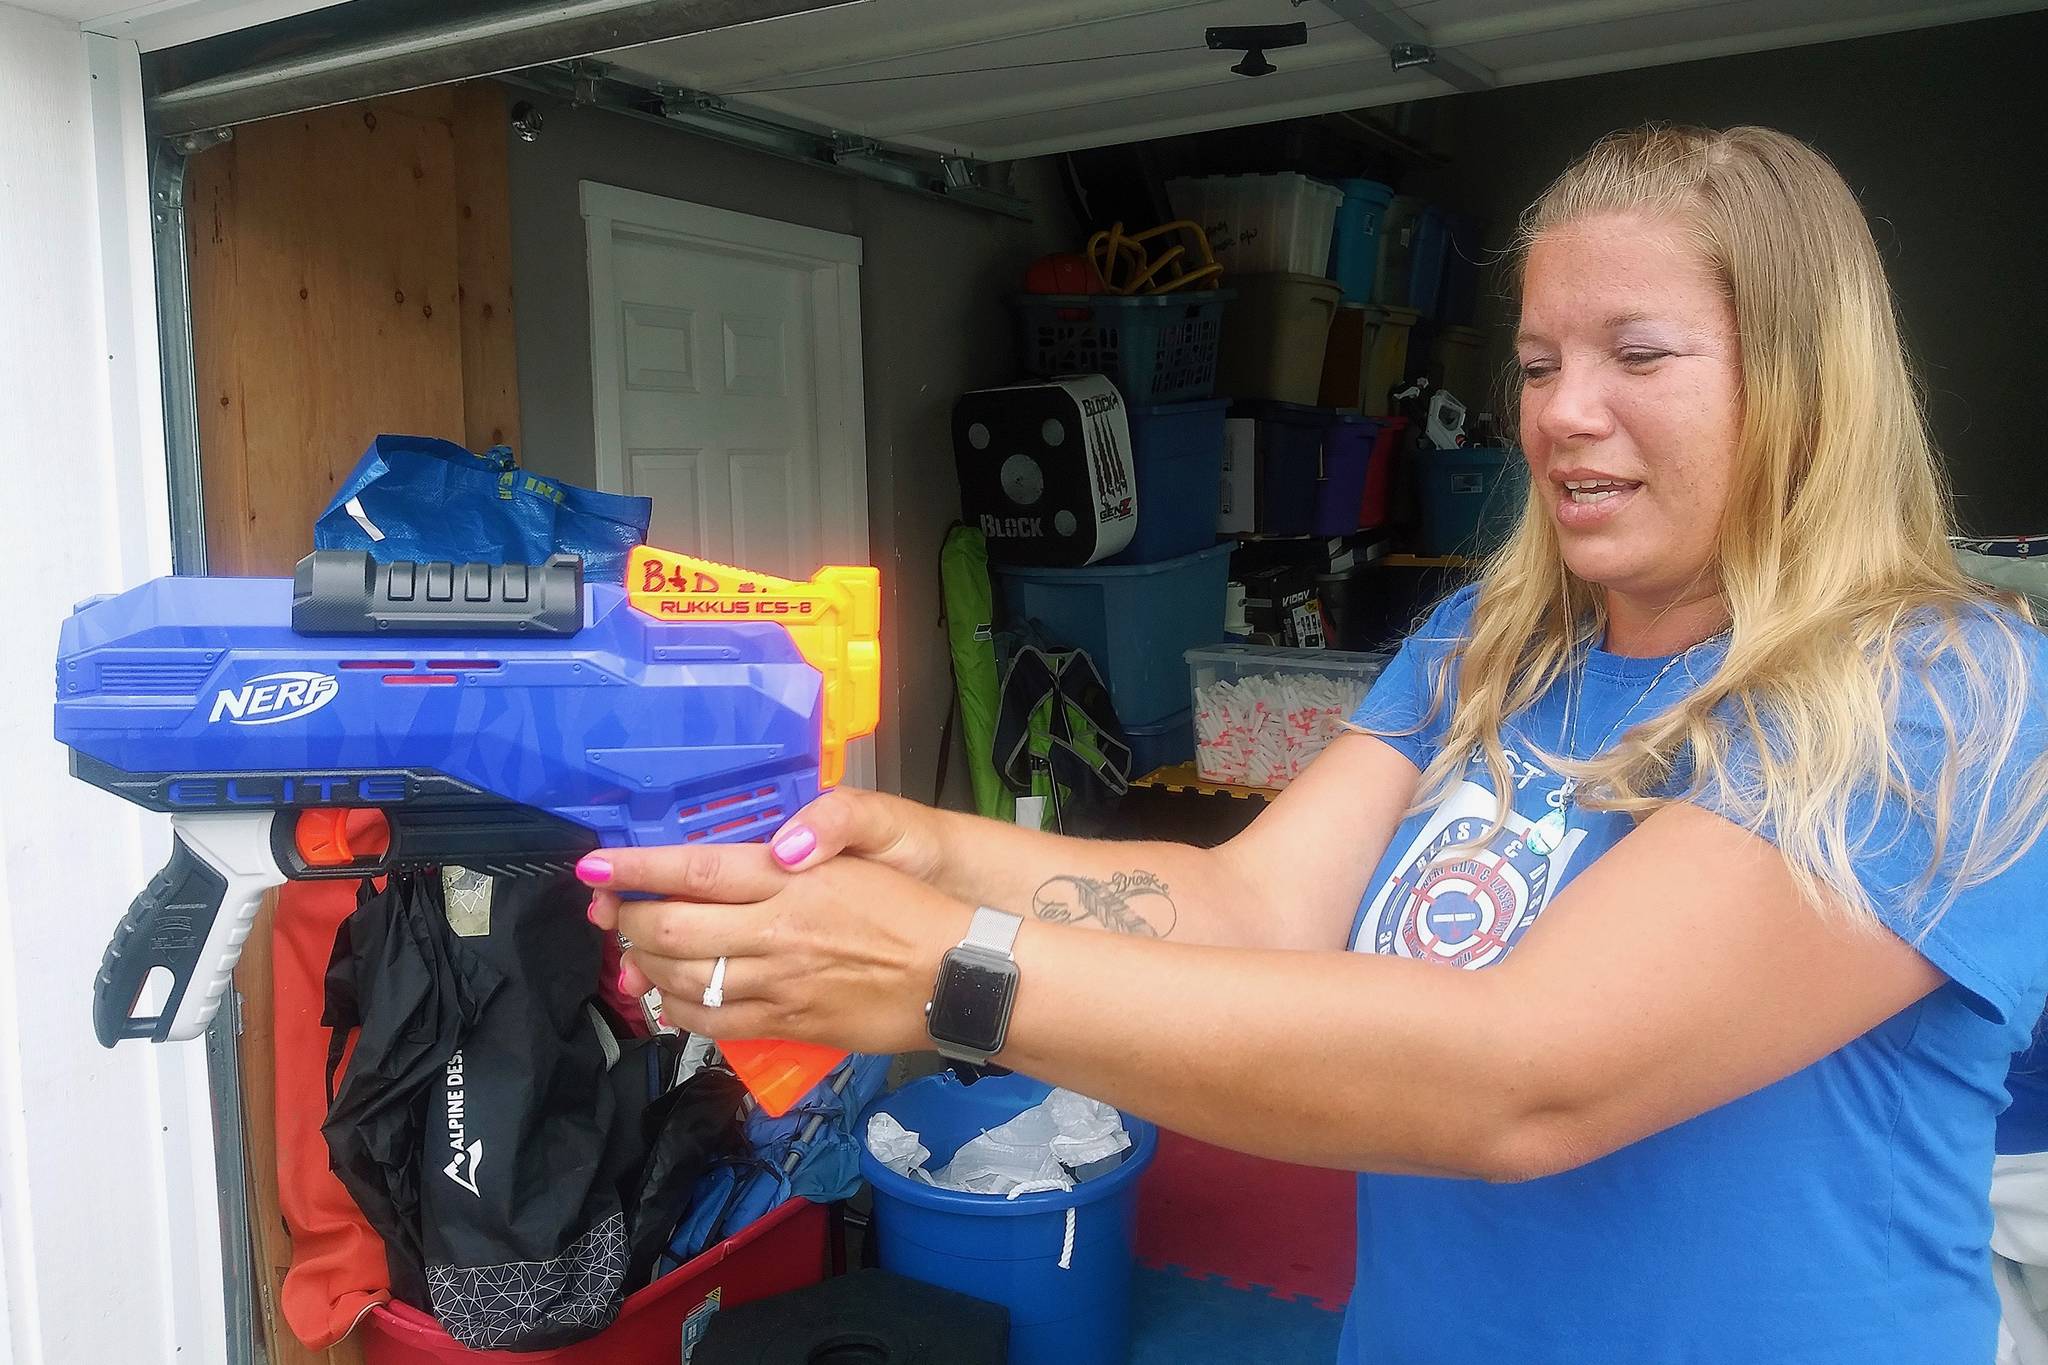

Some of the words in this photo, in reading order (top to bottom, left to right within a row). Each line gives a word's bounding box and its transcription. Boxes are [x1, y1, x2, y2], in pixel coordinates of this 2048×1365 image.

[1081, 395, 1116, 417] BLOCK
[980, 514, 1044, 537] BLOCK
[660, 601, 750, 614] RUKKUS
[756, 601, 812, 614] ICS-8
[208, 673, 339, 723] NERF
[168, 776, 406, 804] ELITE
[1489, 876, 1515, 912] LASER
[1503, 840, 1524, 858] &
[1519, 863, 1549, 928] DASH
[447, 1050, 464, 1086] DES
[447, 1090, 464, 1151] ALPINE
